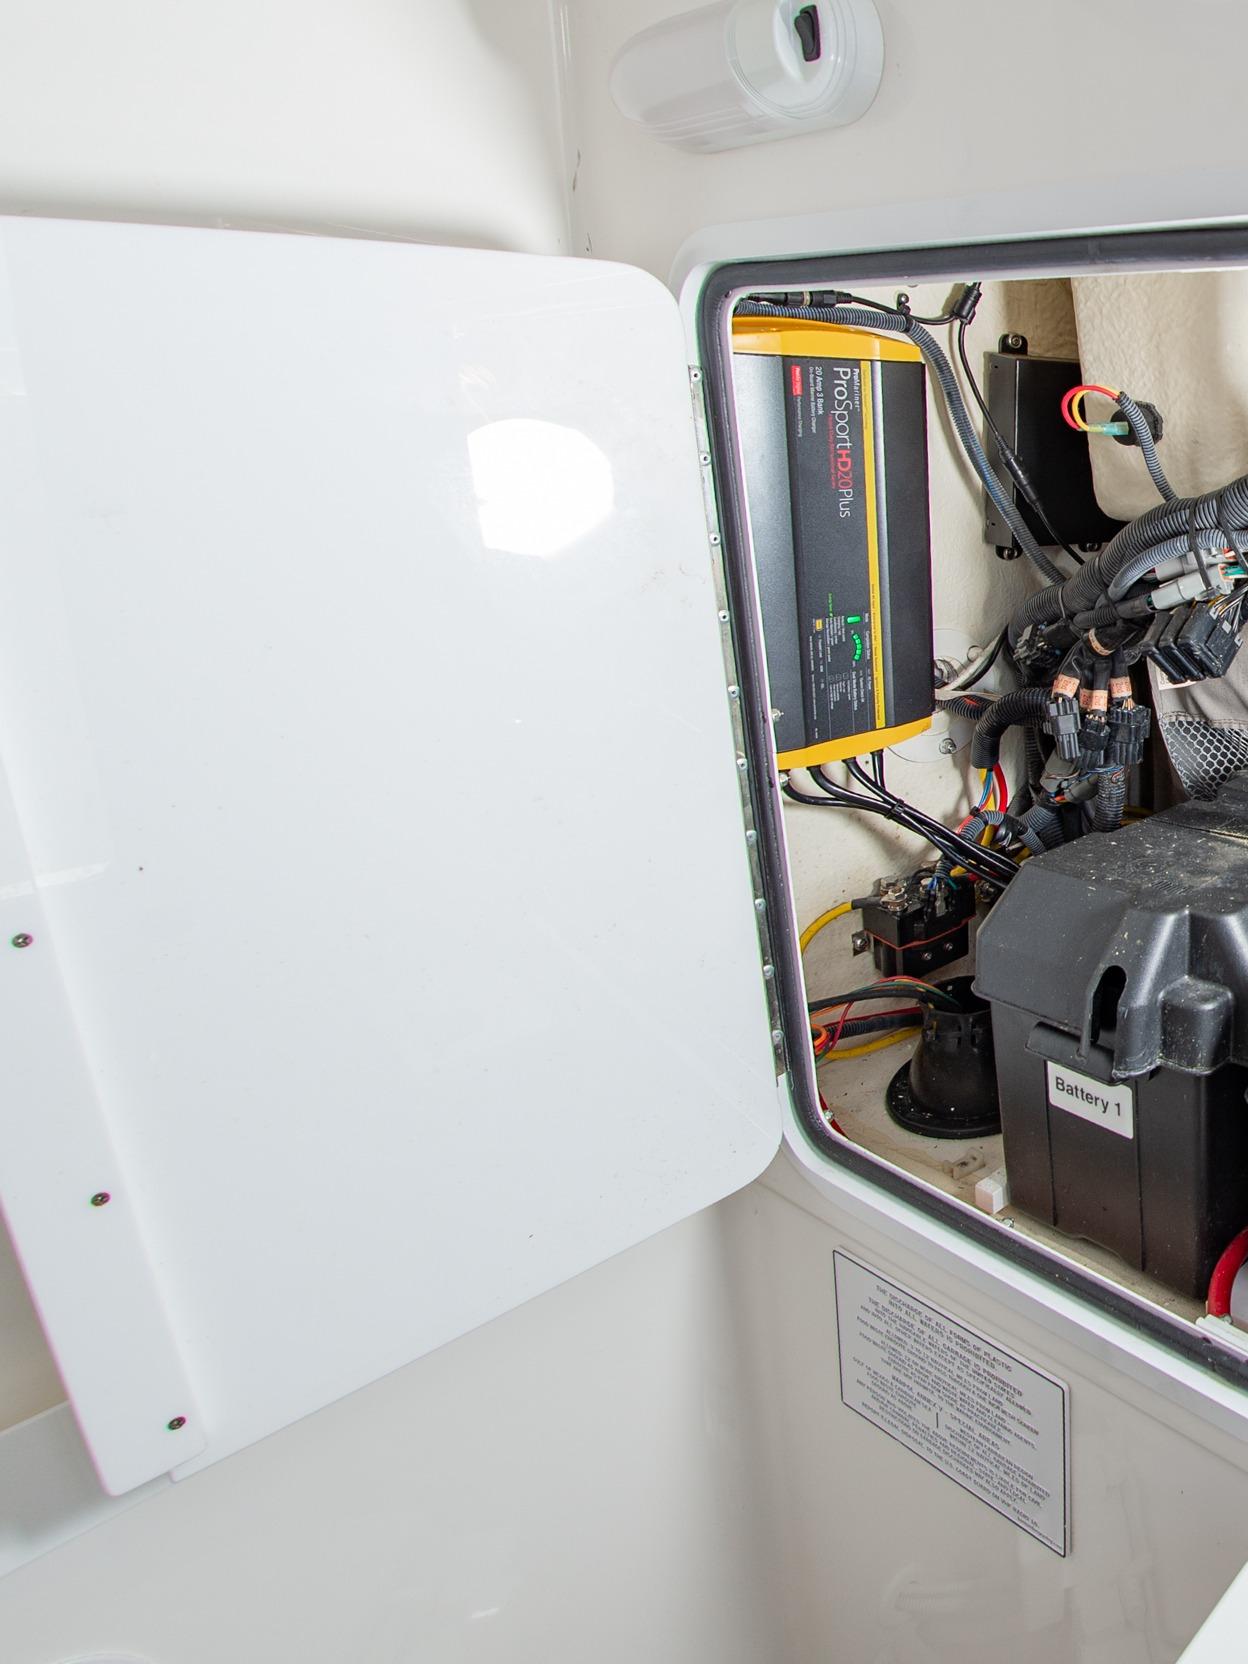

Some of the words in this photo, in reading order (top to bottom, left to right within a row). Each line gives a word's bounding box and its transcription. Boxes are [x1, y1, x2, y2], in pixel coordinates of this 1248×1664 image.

[815, 367, 822, 375] 20
[815, 376, 823, 391] Amp
[1055, 1076, 1109, 1114] Battery
[1115, 1102, 1121, 1117] 1
